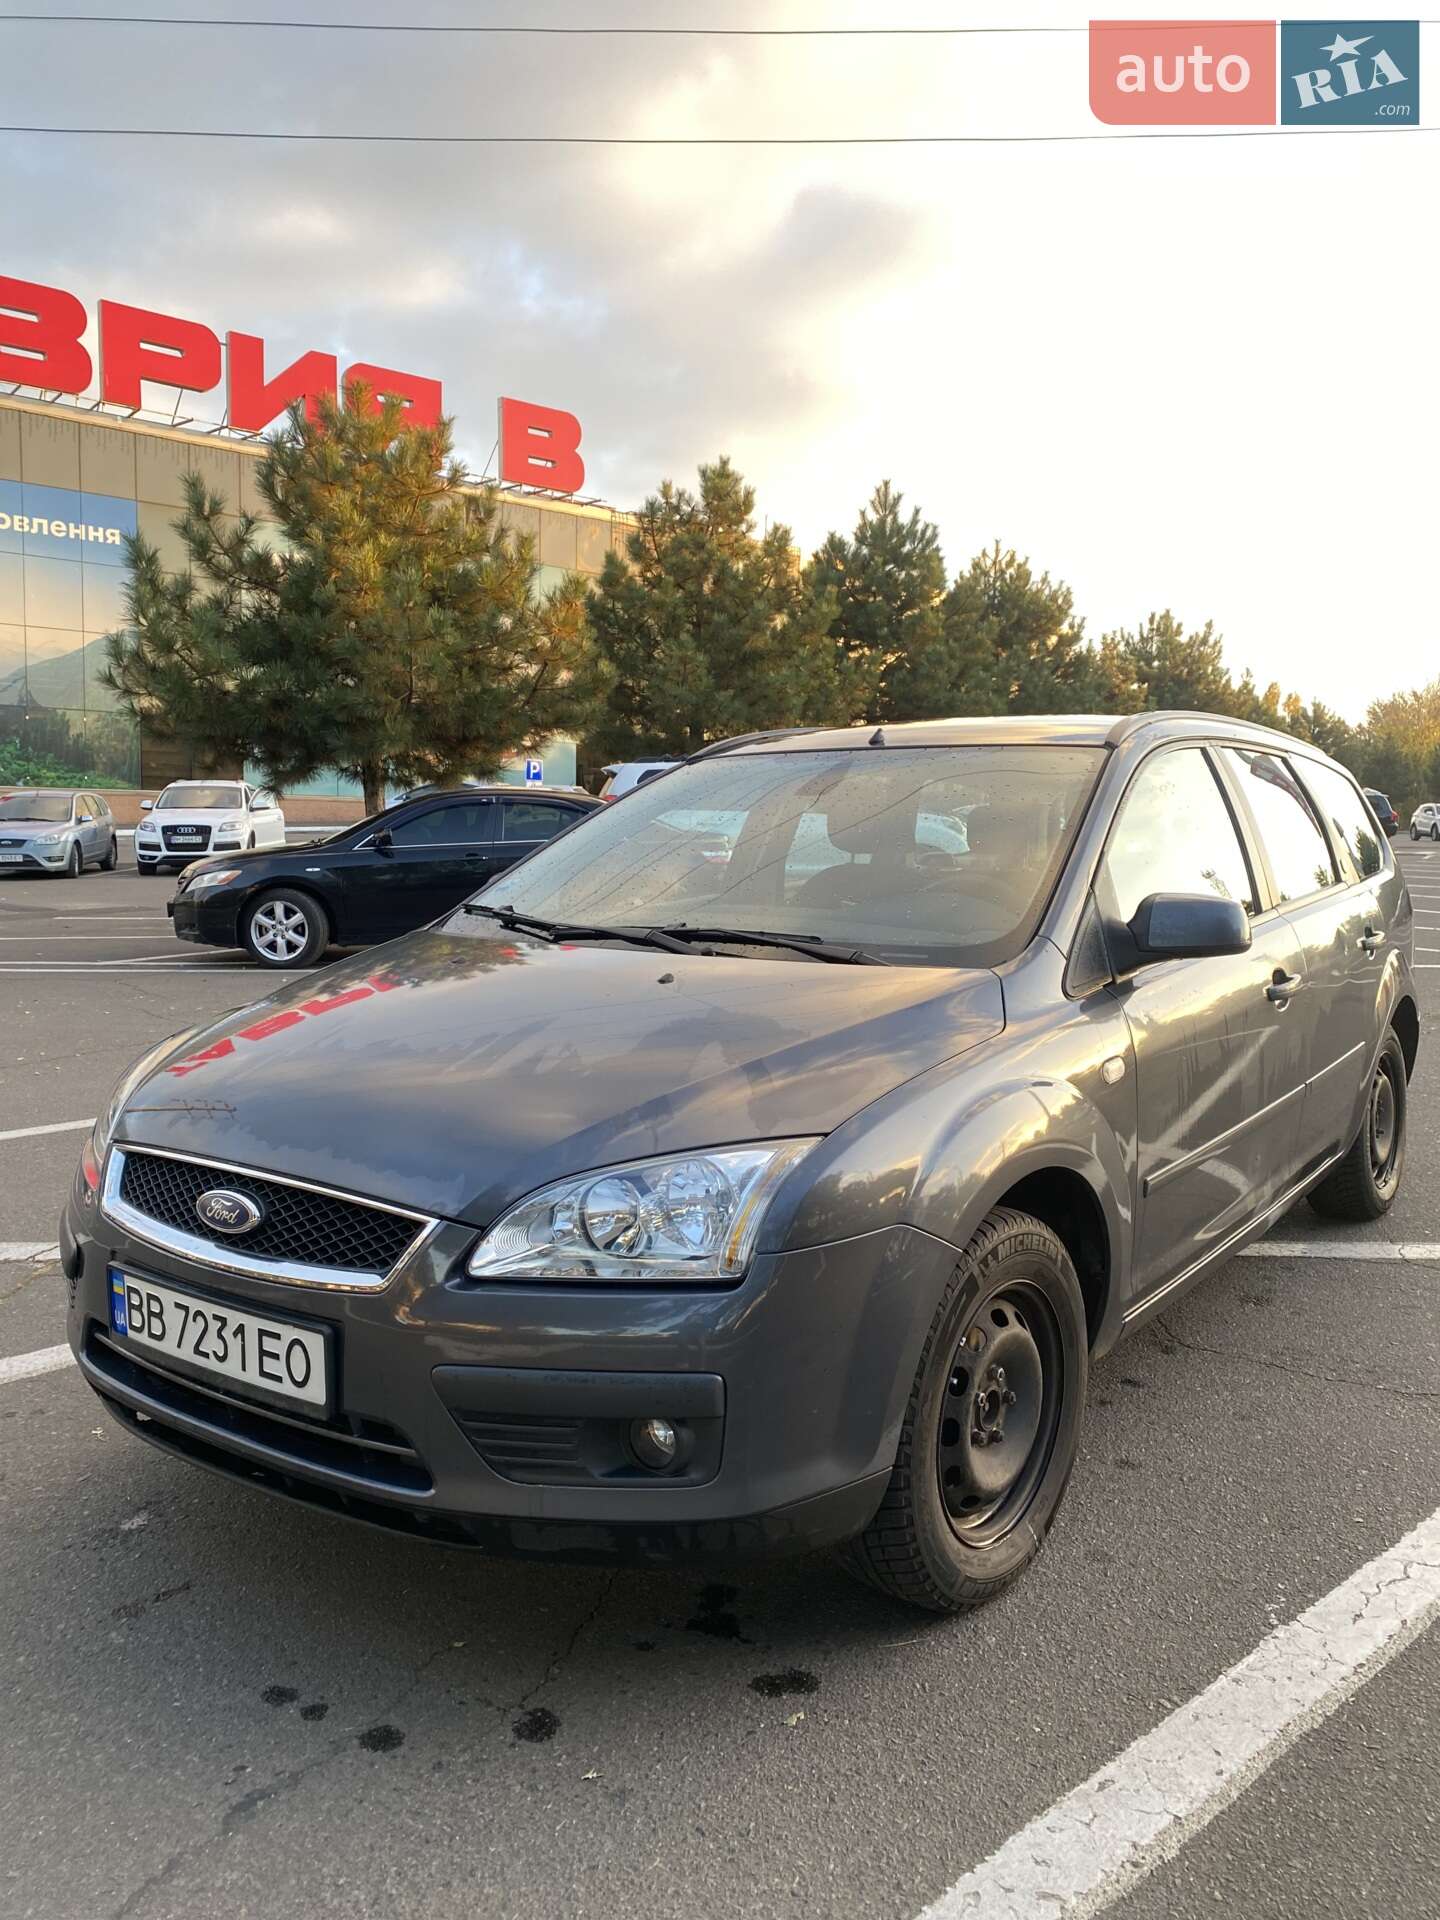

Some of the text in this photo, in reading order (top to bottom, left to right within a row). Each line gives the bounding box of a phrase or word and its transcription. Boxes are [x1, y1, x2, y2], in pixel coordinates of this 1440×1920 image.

[499, 396, 585, 492] В
[530, 761, 540, 779] P
[206, 1197, 240, 1224] Ford
[998, 1233, 1059, 1262] MICHELIN
[114, 1310, 126, 1326] UA
[174, 1301, 247, 1373] 7231
